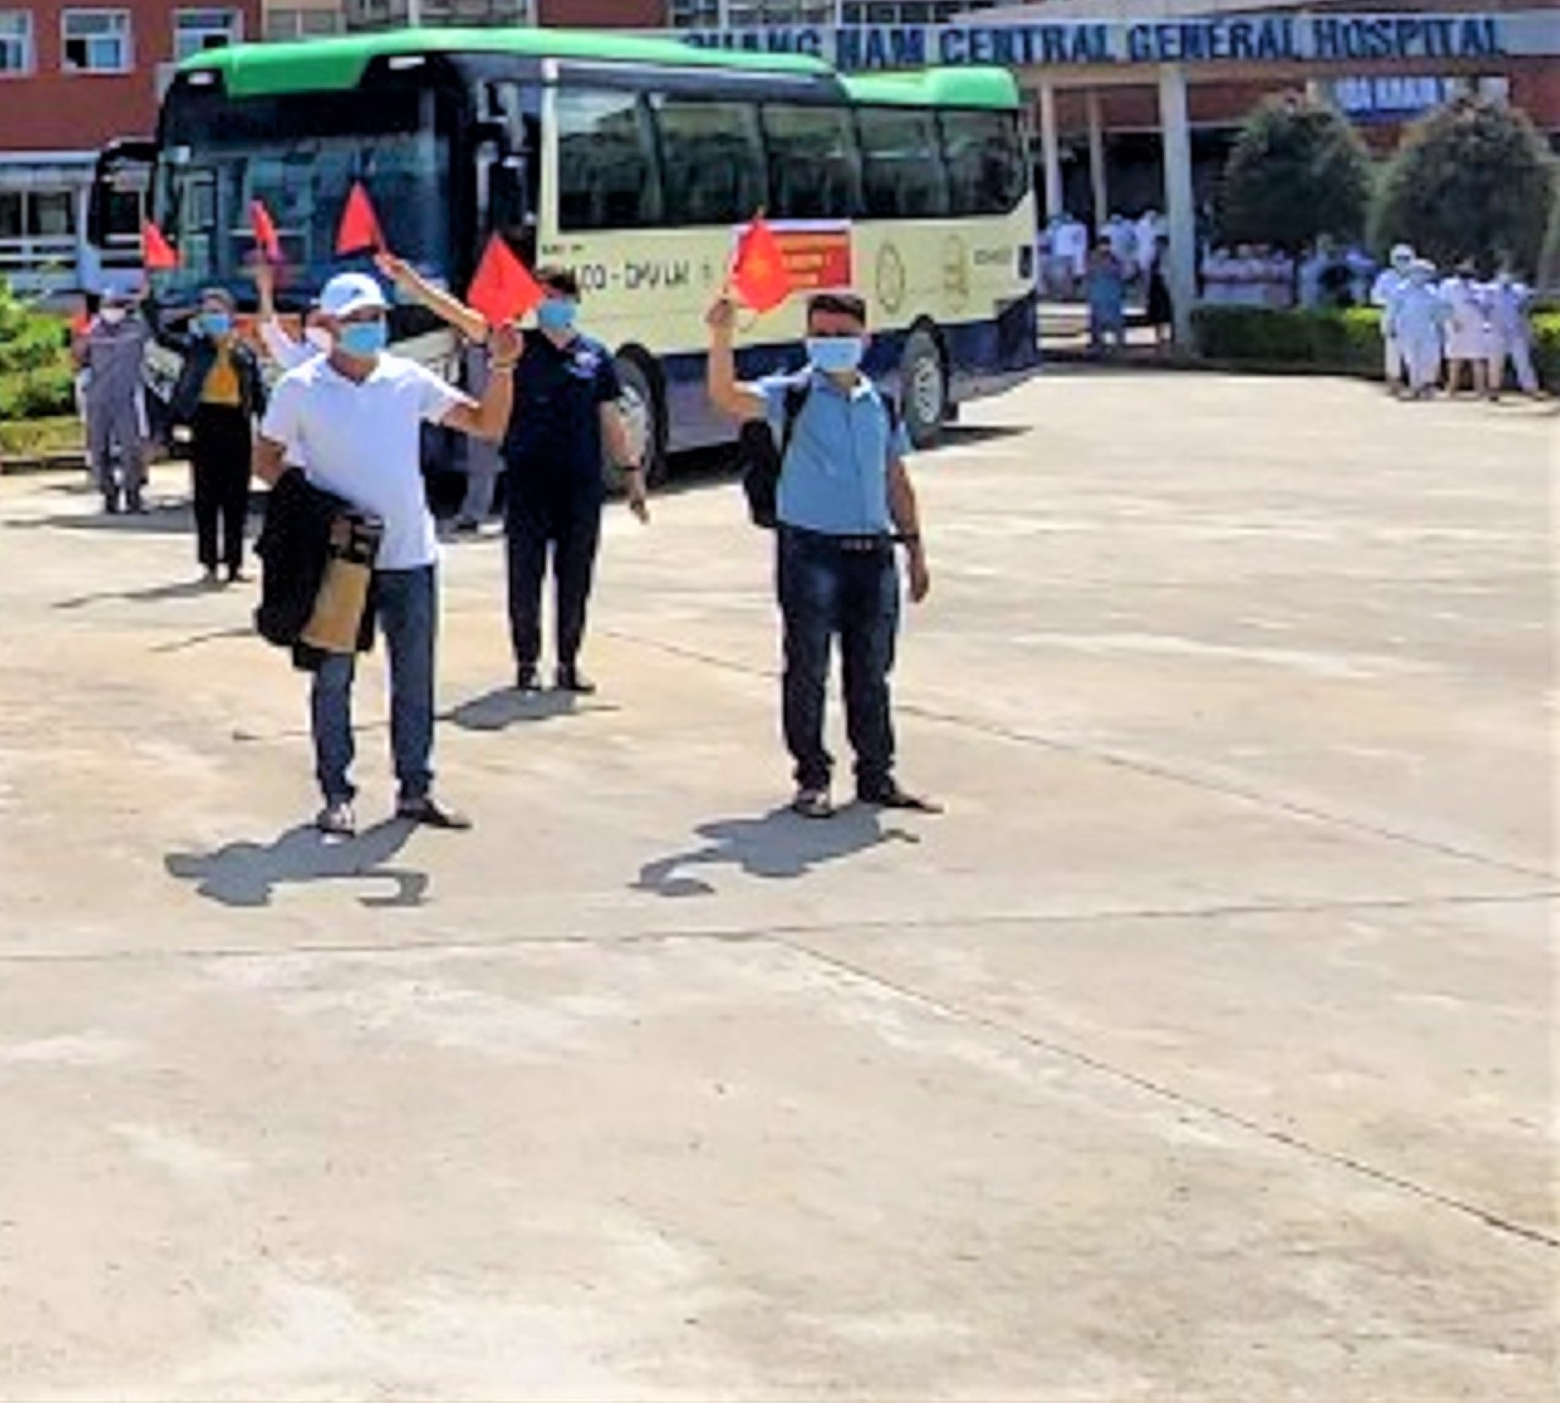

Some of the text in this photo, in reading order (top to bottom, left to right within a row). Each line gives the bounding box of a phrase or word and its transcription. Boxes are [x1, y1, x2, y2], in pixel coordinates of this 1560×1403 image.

[836, 27, 927, 66] NAM
[939, 23, 1116, 64] CENTRAL
[1127, 22, 1301, 62] GENERAL
[1312, 18, 1508, 59] HOSPITAL
